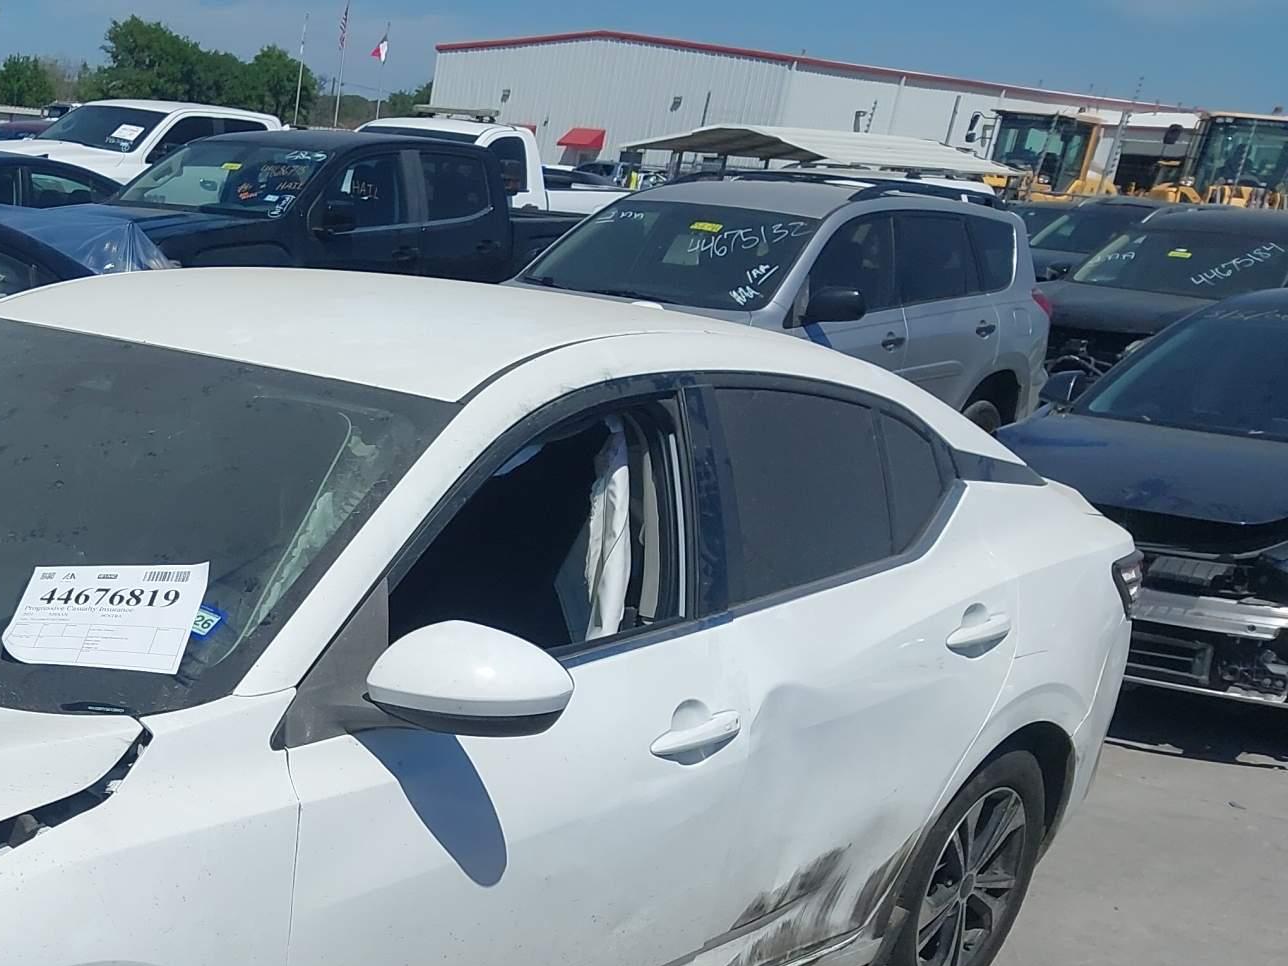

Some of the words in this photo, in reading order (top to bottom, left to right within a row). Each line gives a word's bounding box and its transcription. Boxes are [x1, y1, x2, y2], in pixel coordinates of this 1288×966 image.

[687, 221, 811, 258] 44675132
[1190, 242, 1286, 286] 44675184
[39, 587, 180, 608] 44676819
